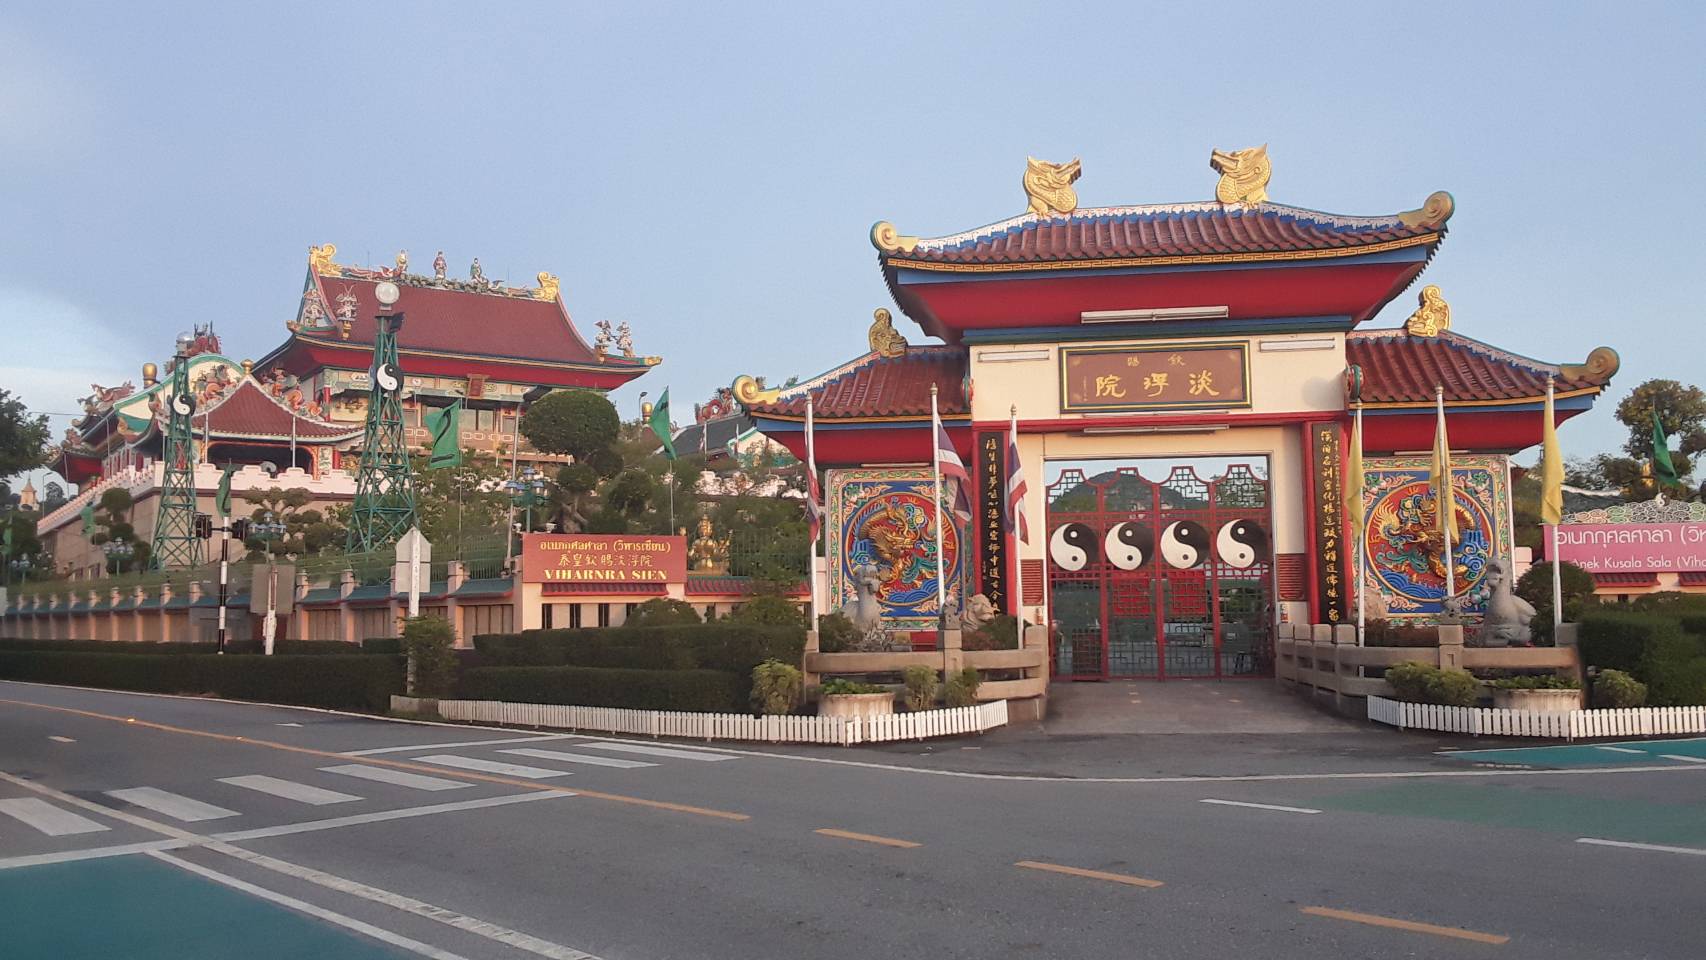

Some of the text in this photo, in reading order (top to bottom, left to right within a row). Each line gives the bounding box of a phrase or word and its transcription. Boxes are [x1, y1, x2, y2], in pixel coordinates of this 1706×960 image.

[1604, 555, 1642, 568] Kusala
[1646, 554, 1672, 568] Sala
[544, 569, 667, 580] VIHARNRA SIEN
